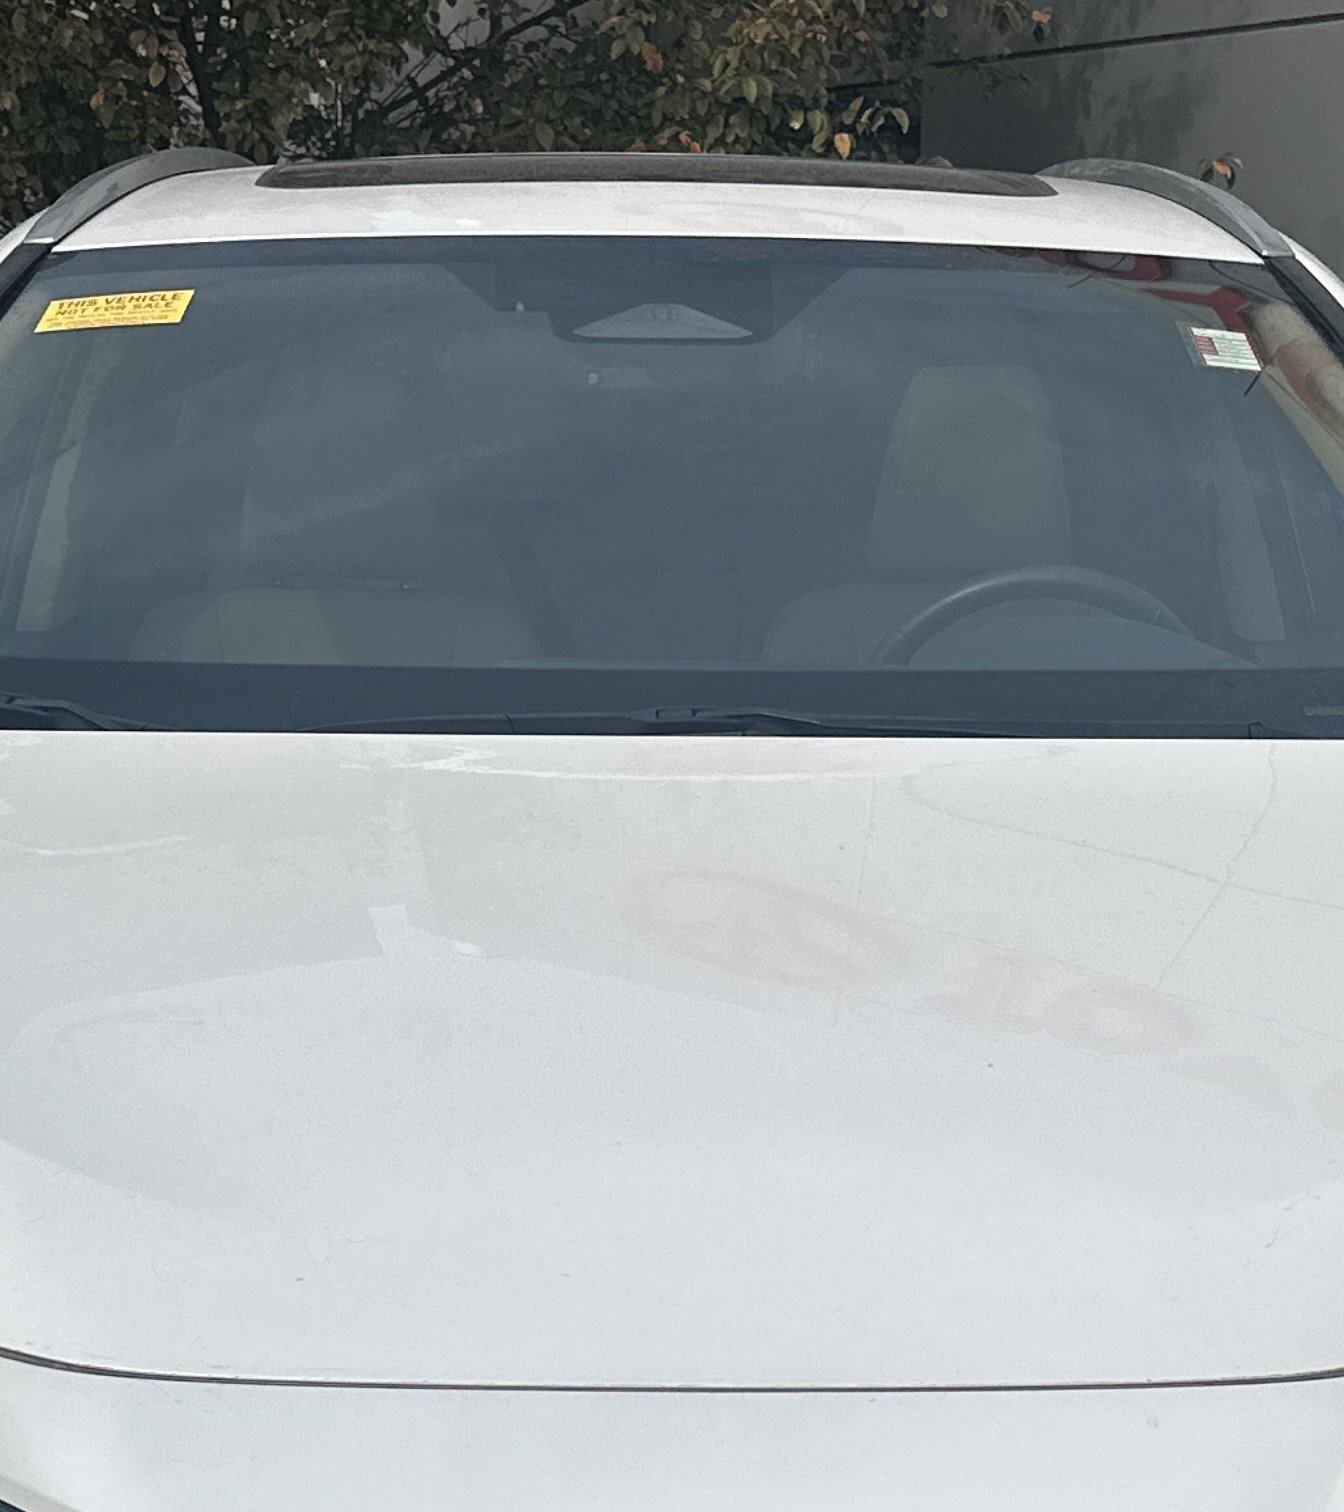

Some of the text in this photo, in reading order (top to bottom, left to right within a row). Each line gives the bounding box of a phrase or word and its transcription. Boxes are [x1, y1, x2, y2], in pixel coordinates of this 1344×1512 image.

[55, 308, 87, 316] NOT
[133, 301, 173, 311] SALE
[58, 292, 184, 310] THIS VEHICLE
